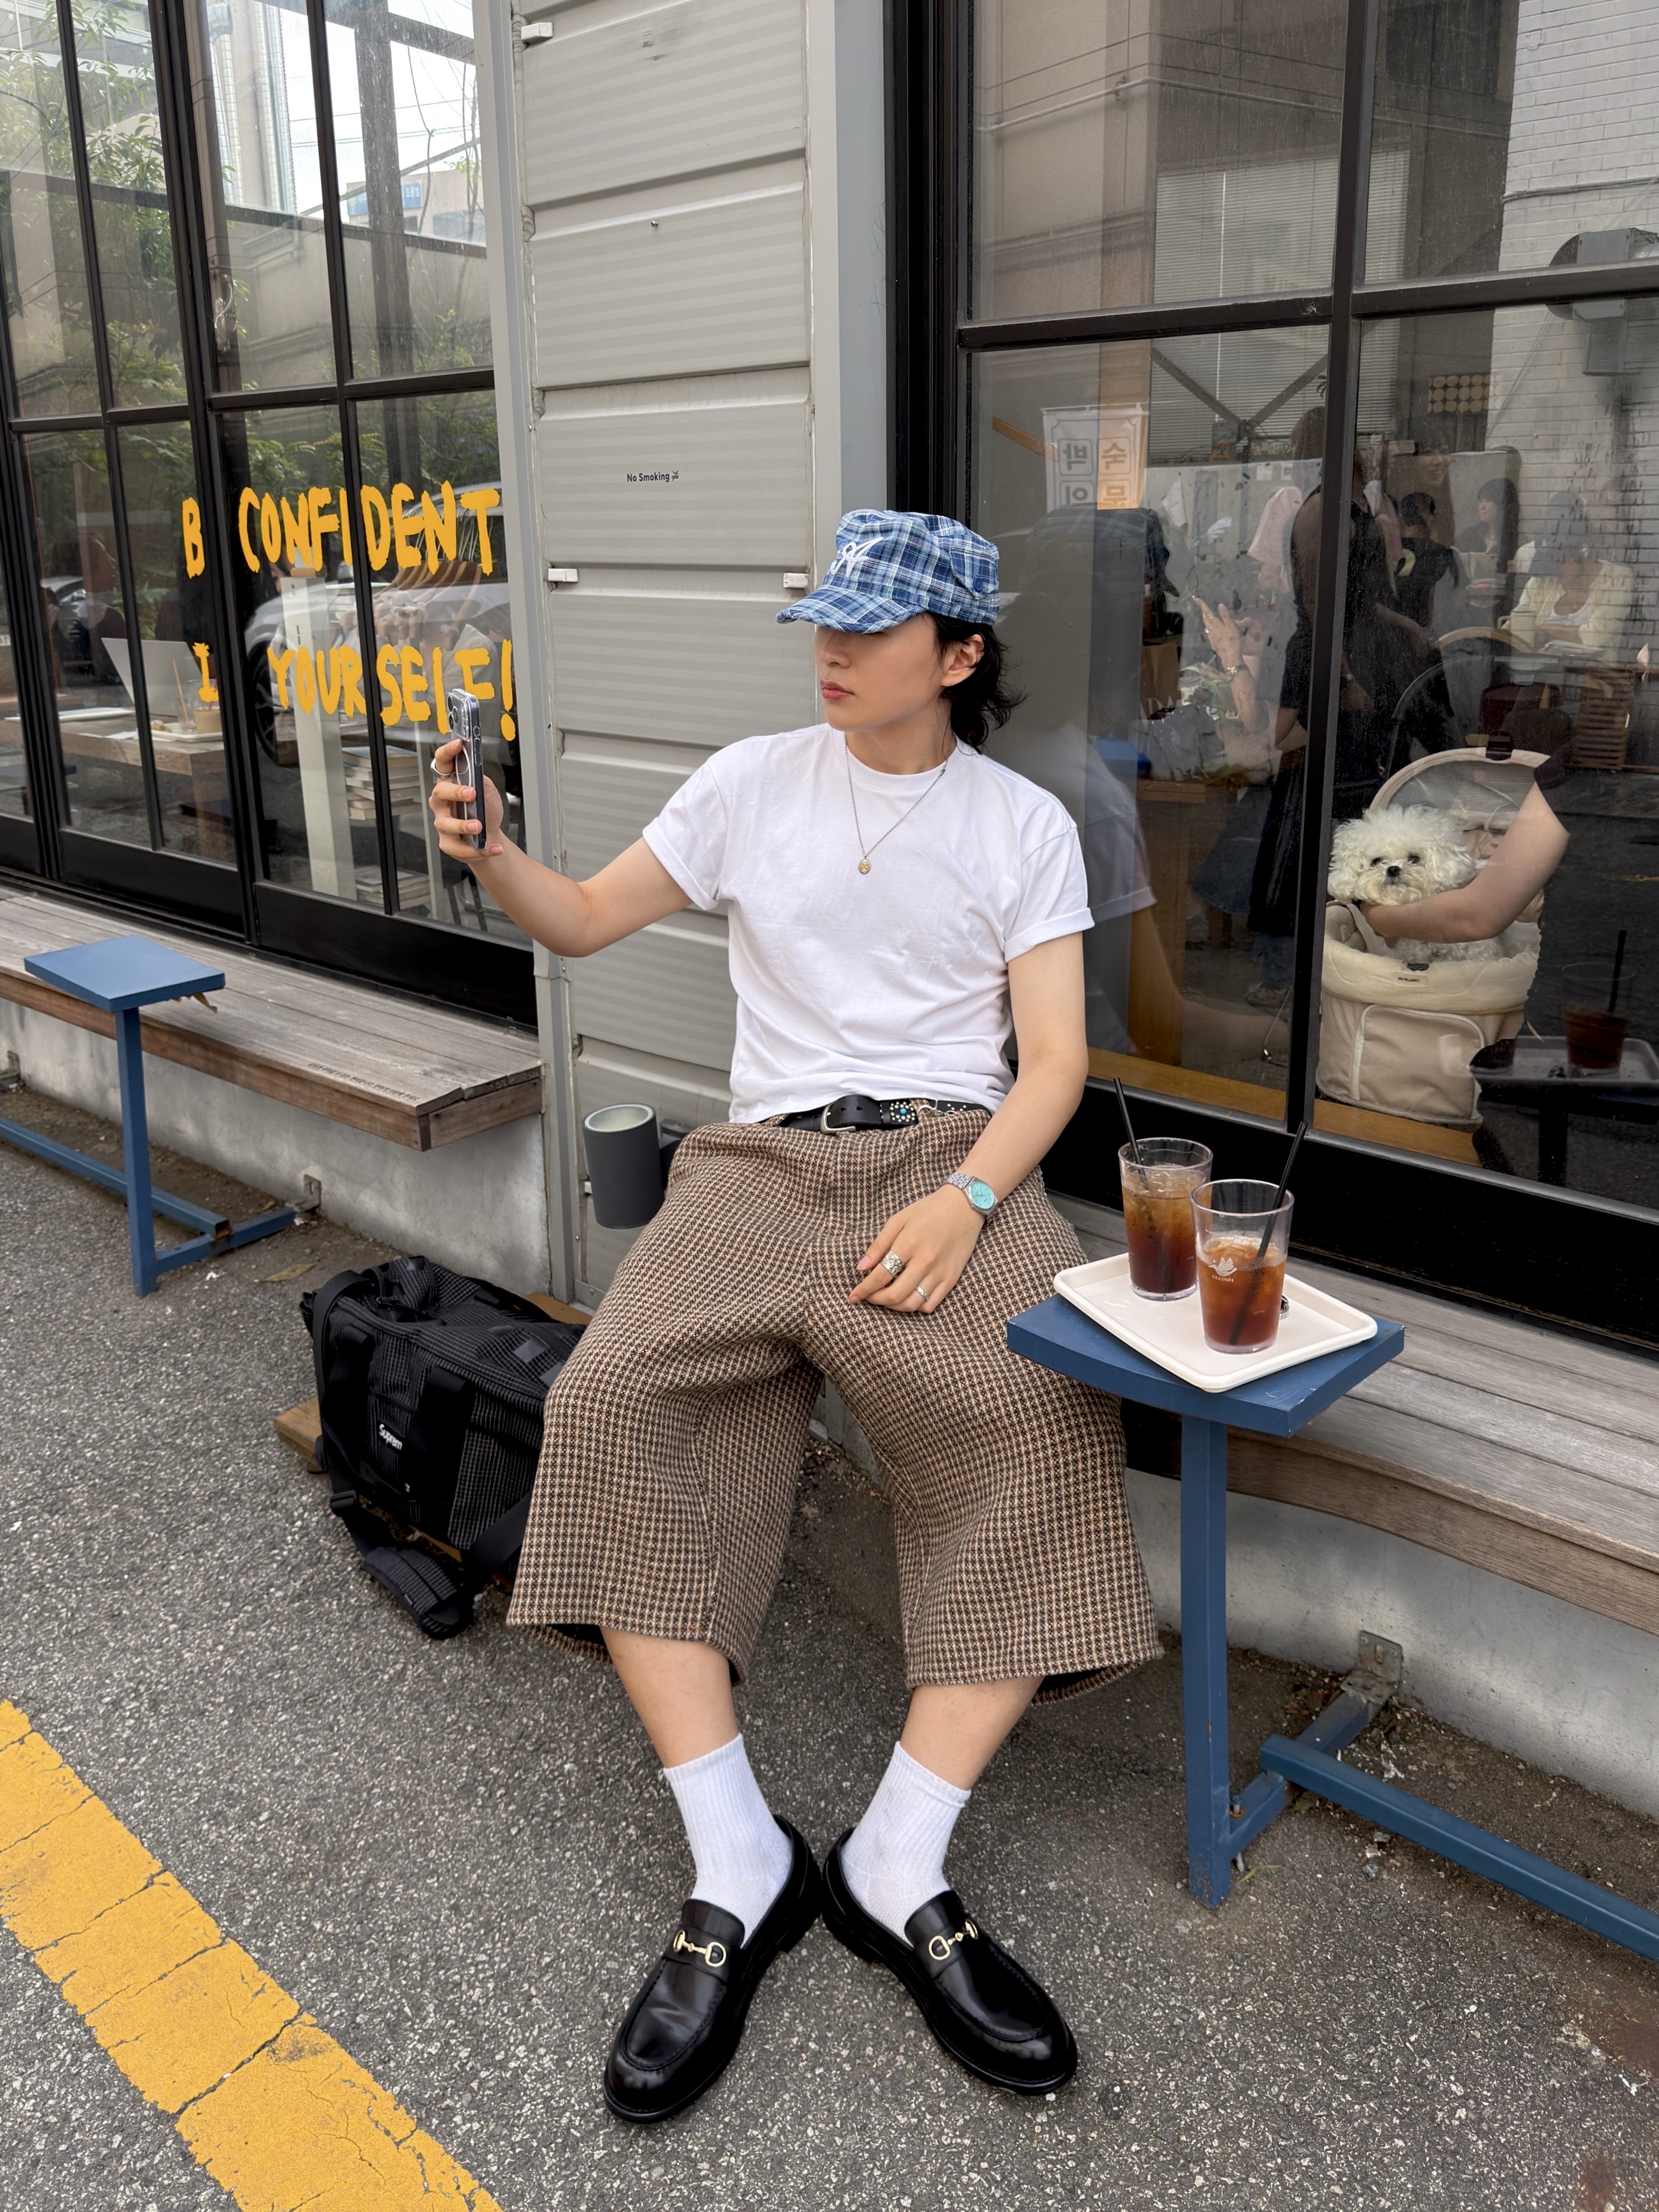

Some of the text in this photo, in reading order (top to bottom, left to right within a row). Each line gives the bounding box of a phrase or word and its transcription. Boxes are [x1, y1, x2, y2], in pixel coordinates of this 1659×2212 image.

[627, 471, 670, 483] No Smoking
[239, 480, 500, 576] CONFIDENT
